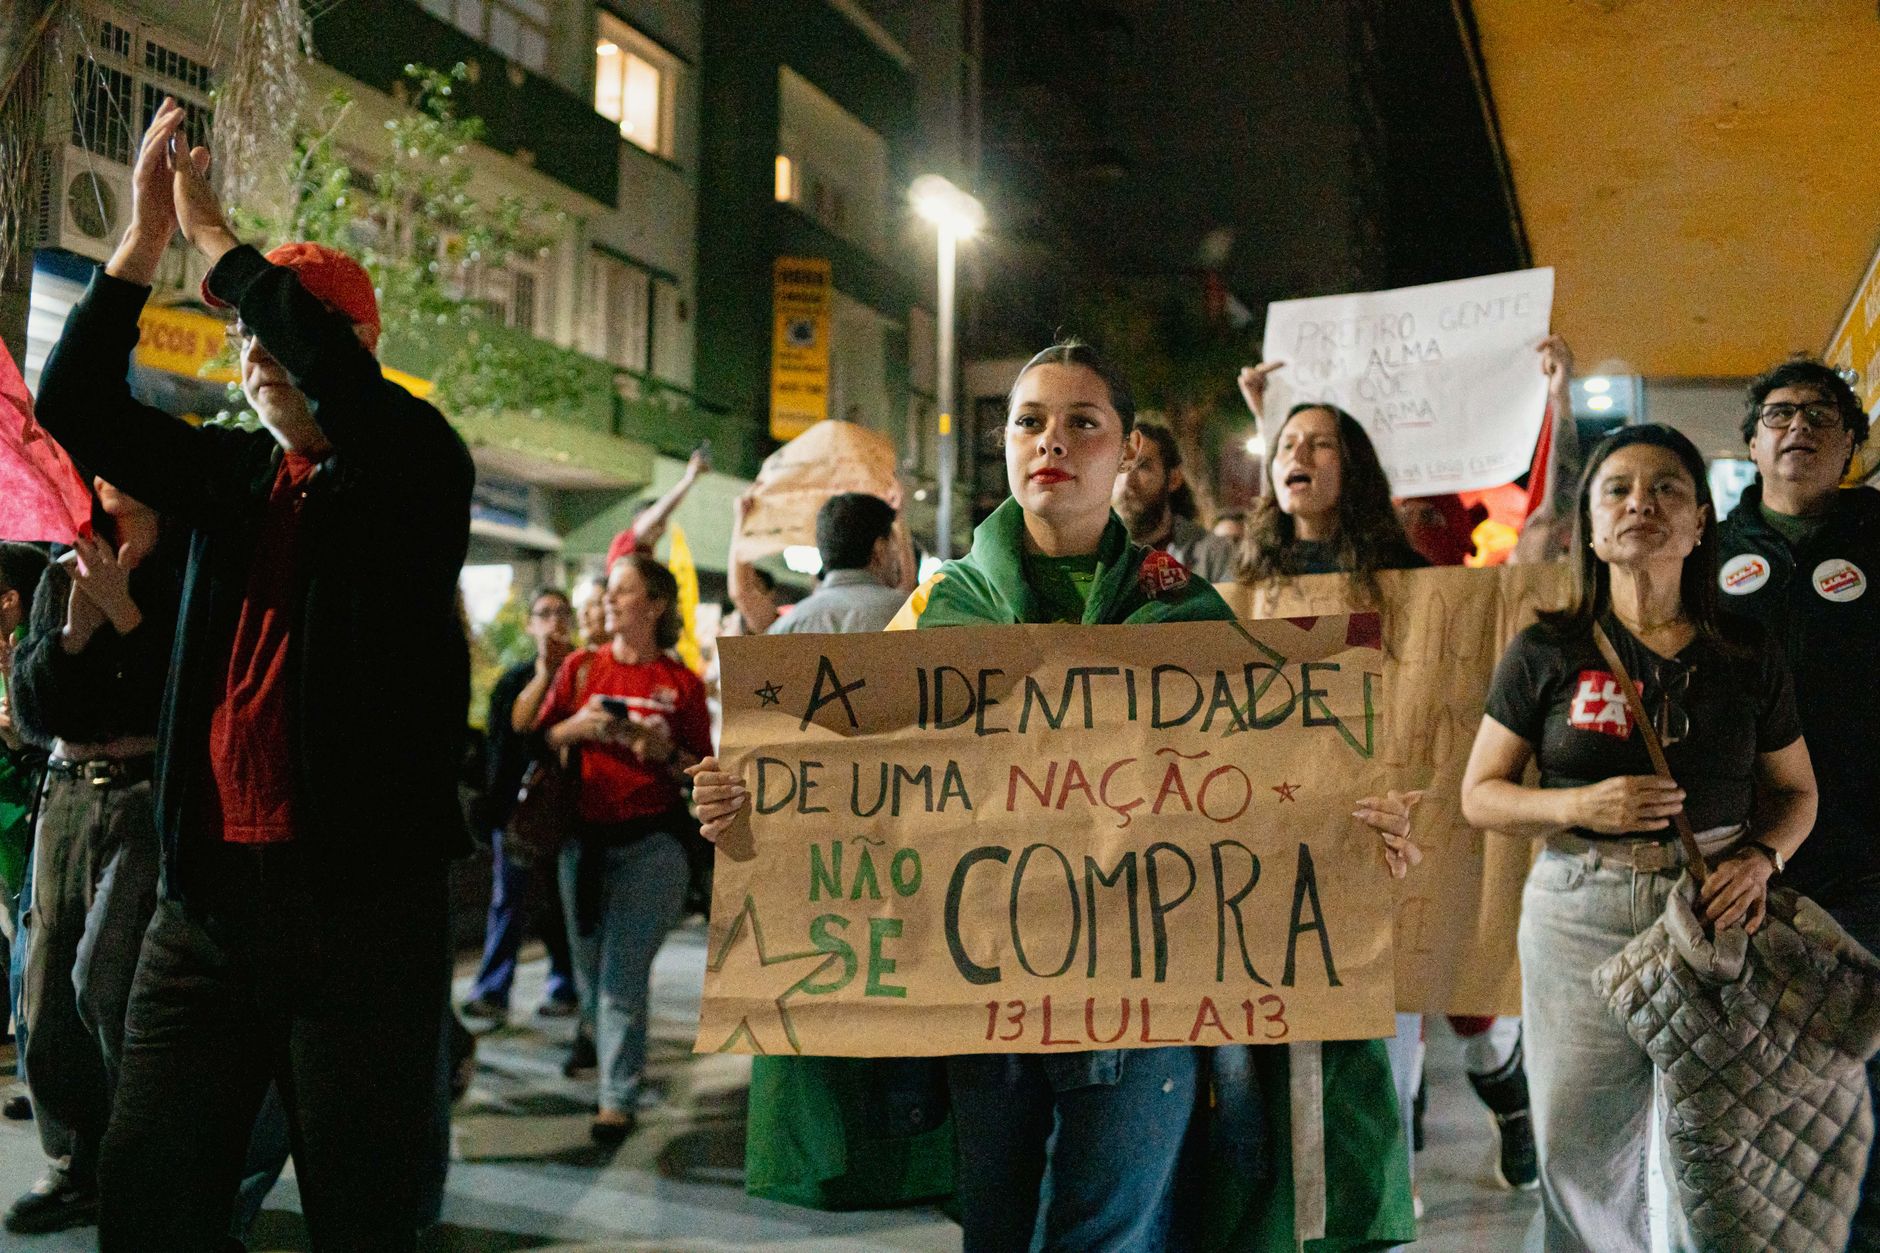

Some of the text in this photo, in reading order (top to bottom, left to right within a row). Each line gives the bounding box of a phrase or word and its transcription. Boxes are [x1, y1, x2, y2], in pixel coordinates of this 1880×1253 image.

[1438, 292, 1530, 332] GENTE
[1364, 337, 1443, 382] ALMA
[1372, 397, 1438, 434] ARMA
[800, 655, 866, 732] A
[917, 662, 1341, 737] IDENTIDADE
[756, 747, 1252, 828] DE UMA NAÇÃO
[808, 835, 922, 901] NÃO
[944, 839, 1343, 987] COMPRA
[798, 914, 907, 998] SE
